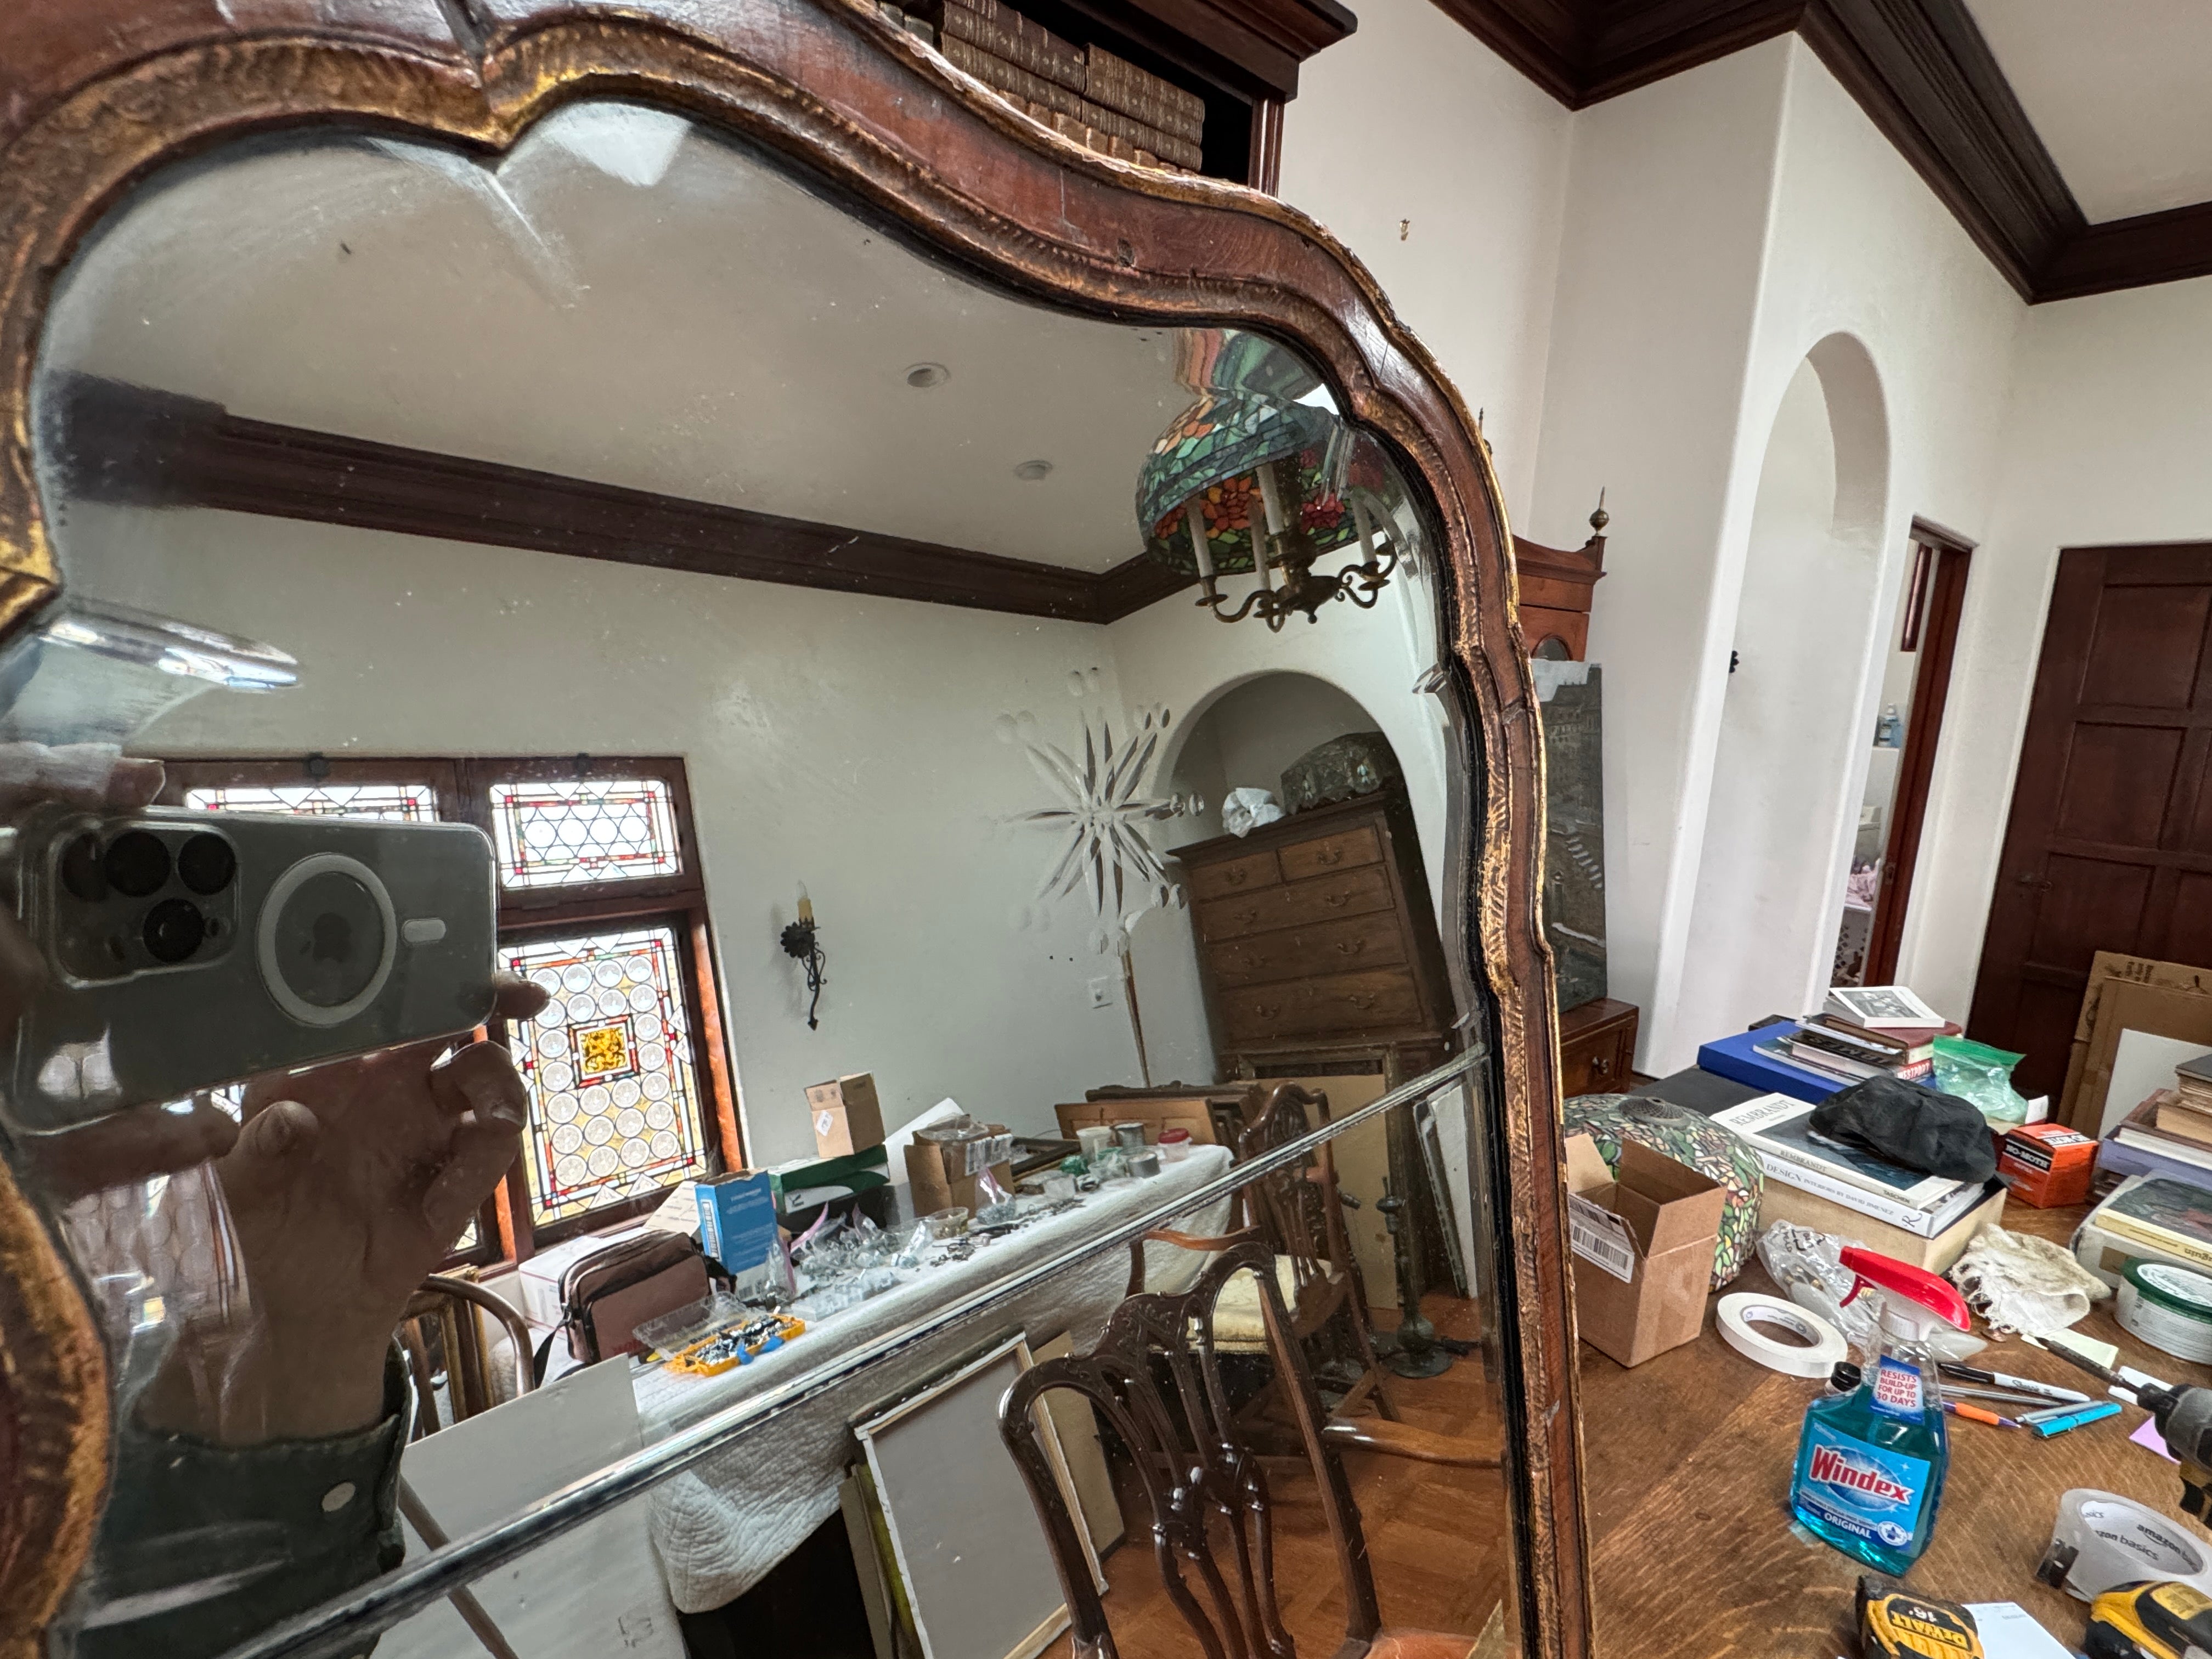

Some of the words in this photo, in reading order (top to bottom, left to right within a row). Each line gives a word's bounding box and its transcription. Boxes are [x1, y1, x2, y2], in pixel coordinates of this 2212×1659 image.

[1897, 1062, 1930, 1080] WESTPORT
[1729, 1099, 1796, 1126] REMBRANDT
[1780, 1149, 1827, 1172] REMBRANDT
[2005, 1144, 2050, 1169] NO-MOTH
[1766, 1163, 1803, 1182] DESIGN
[1804, 1179, 1836, 1194] INTERIORS
[1845, 1194, 1865, 1205] DAVID
[1882, 1189, 1910, 1204] TASCHEN
[1880, 1377, 1917, 1390] BUILD-UP
[1881, 1369, 1917, 1383] RESISTS
[1876, 1392, 1888, 1401] 30
[1890, 1395, 1916, 1408] DAYS
[1878, 1385, 1893, 1393] FOR
[1810, 1444, 1914, 1505] Windex
[1824, 1512, 1872, 1539] ORIGINAL
[2120, 1535, 2159, 1561] basics
[2137, 1524, 2181, 1555] amazon
[1891, 1612, 1967, 1646] DEWALT
